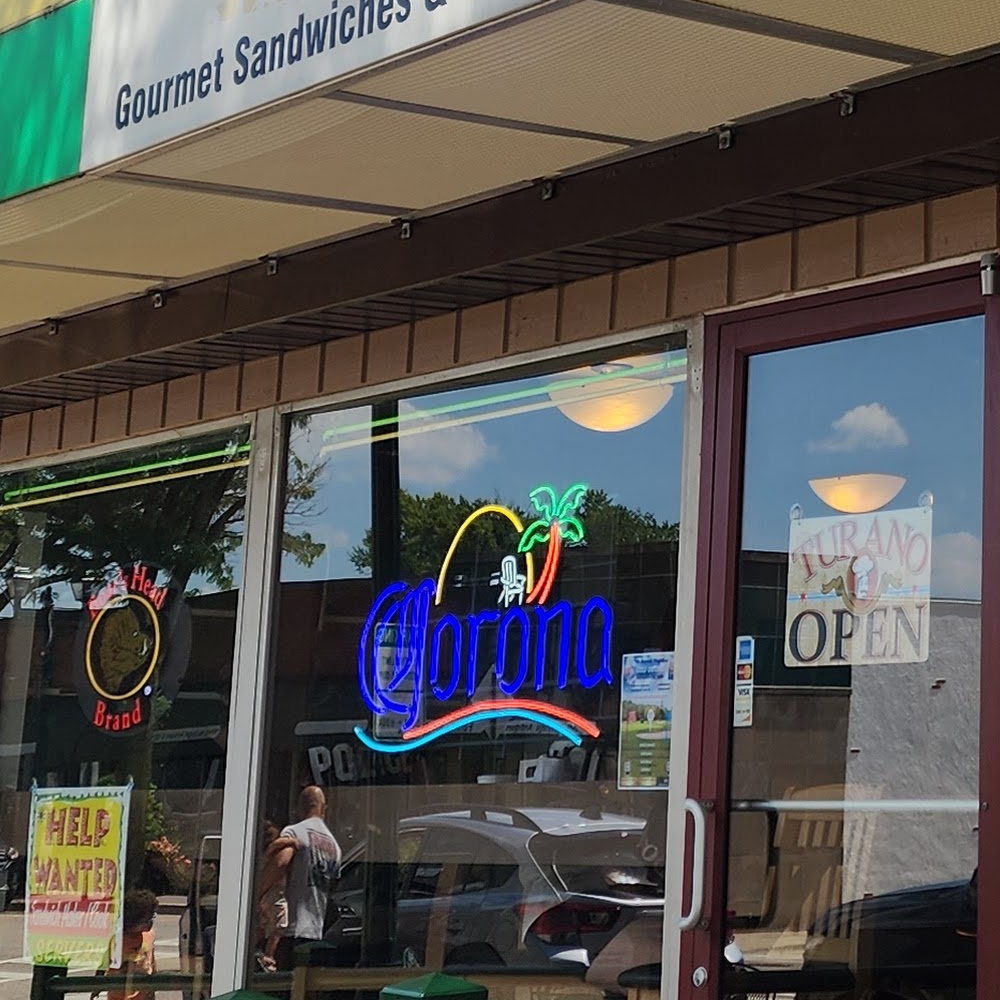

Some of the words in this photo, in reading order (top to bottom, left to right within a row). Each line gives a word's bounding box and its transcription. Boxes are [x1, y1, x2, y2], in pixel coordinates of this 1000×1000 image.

[115, 55, 224, 130] Gourmet
[791, 516, 929, 583] TURANO
[358, 577, 614, 731] Corona
[788, 603, 927, 664] OPEN
[93, 697, 142, 731] Brand
[45, 805, 111, 848] HELP
[33, 854, 118, 901] WANTED
